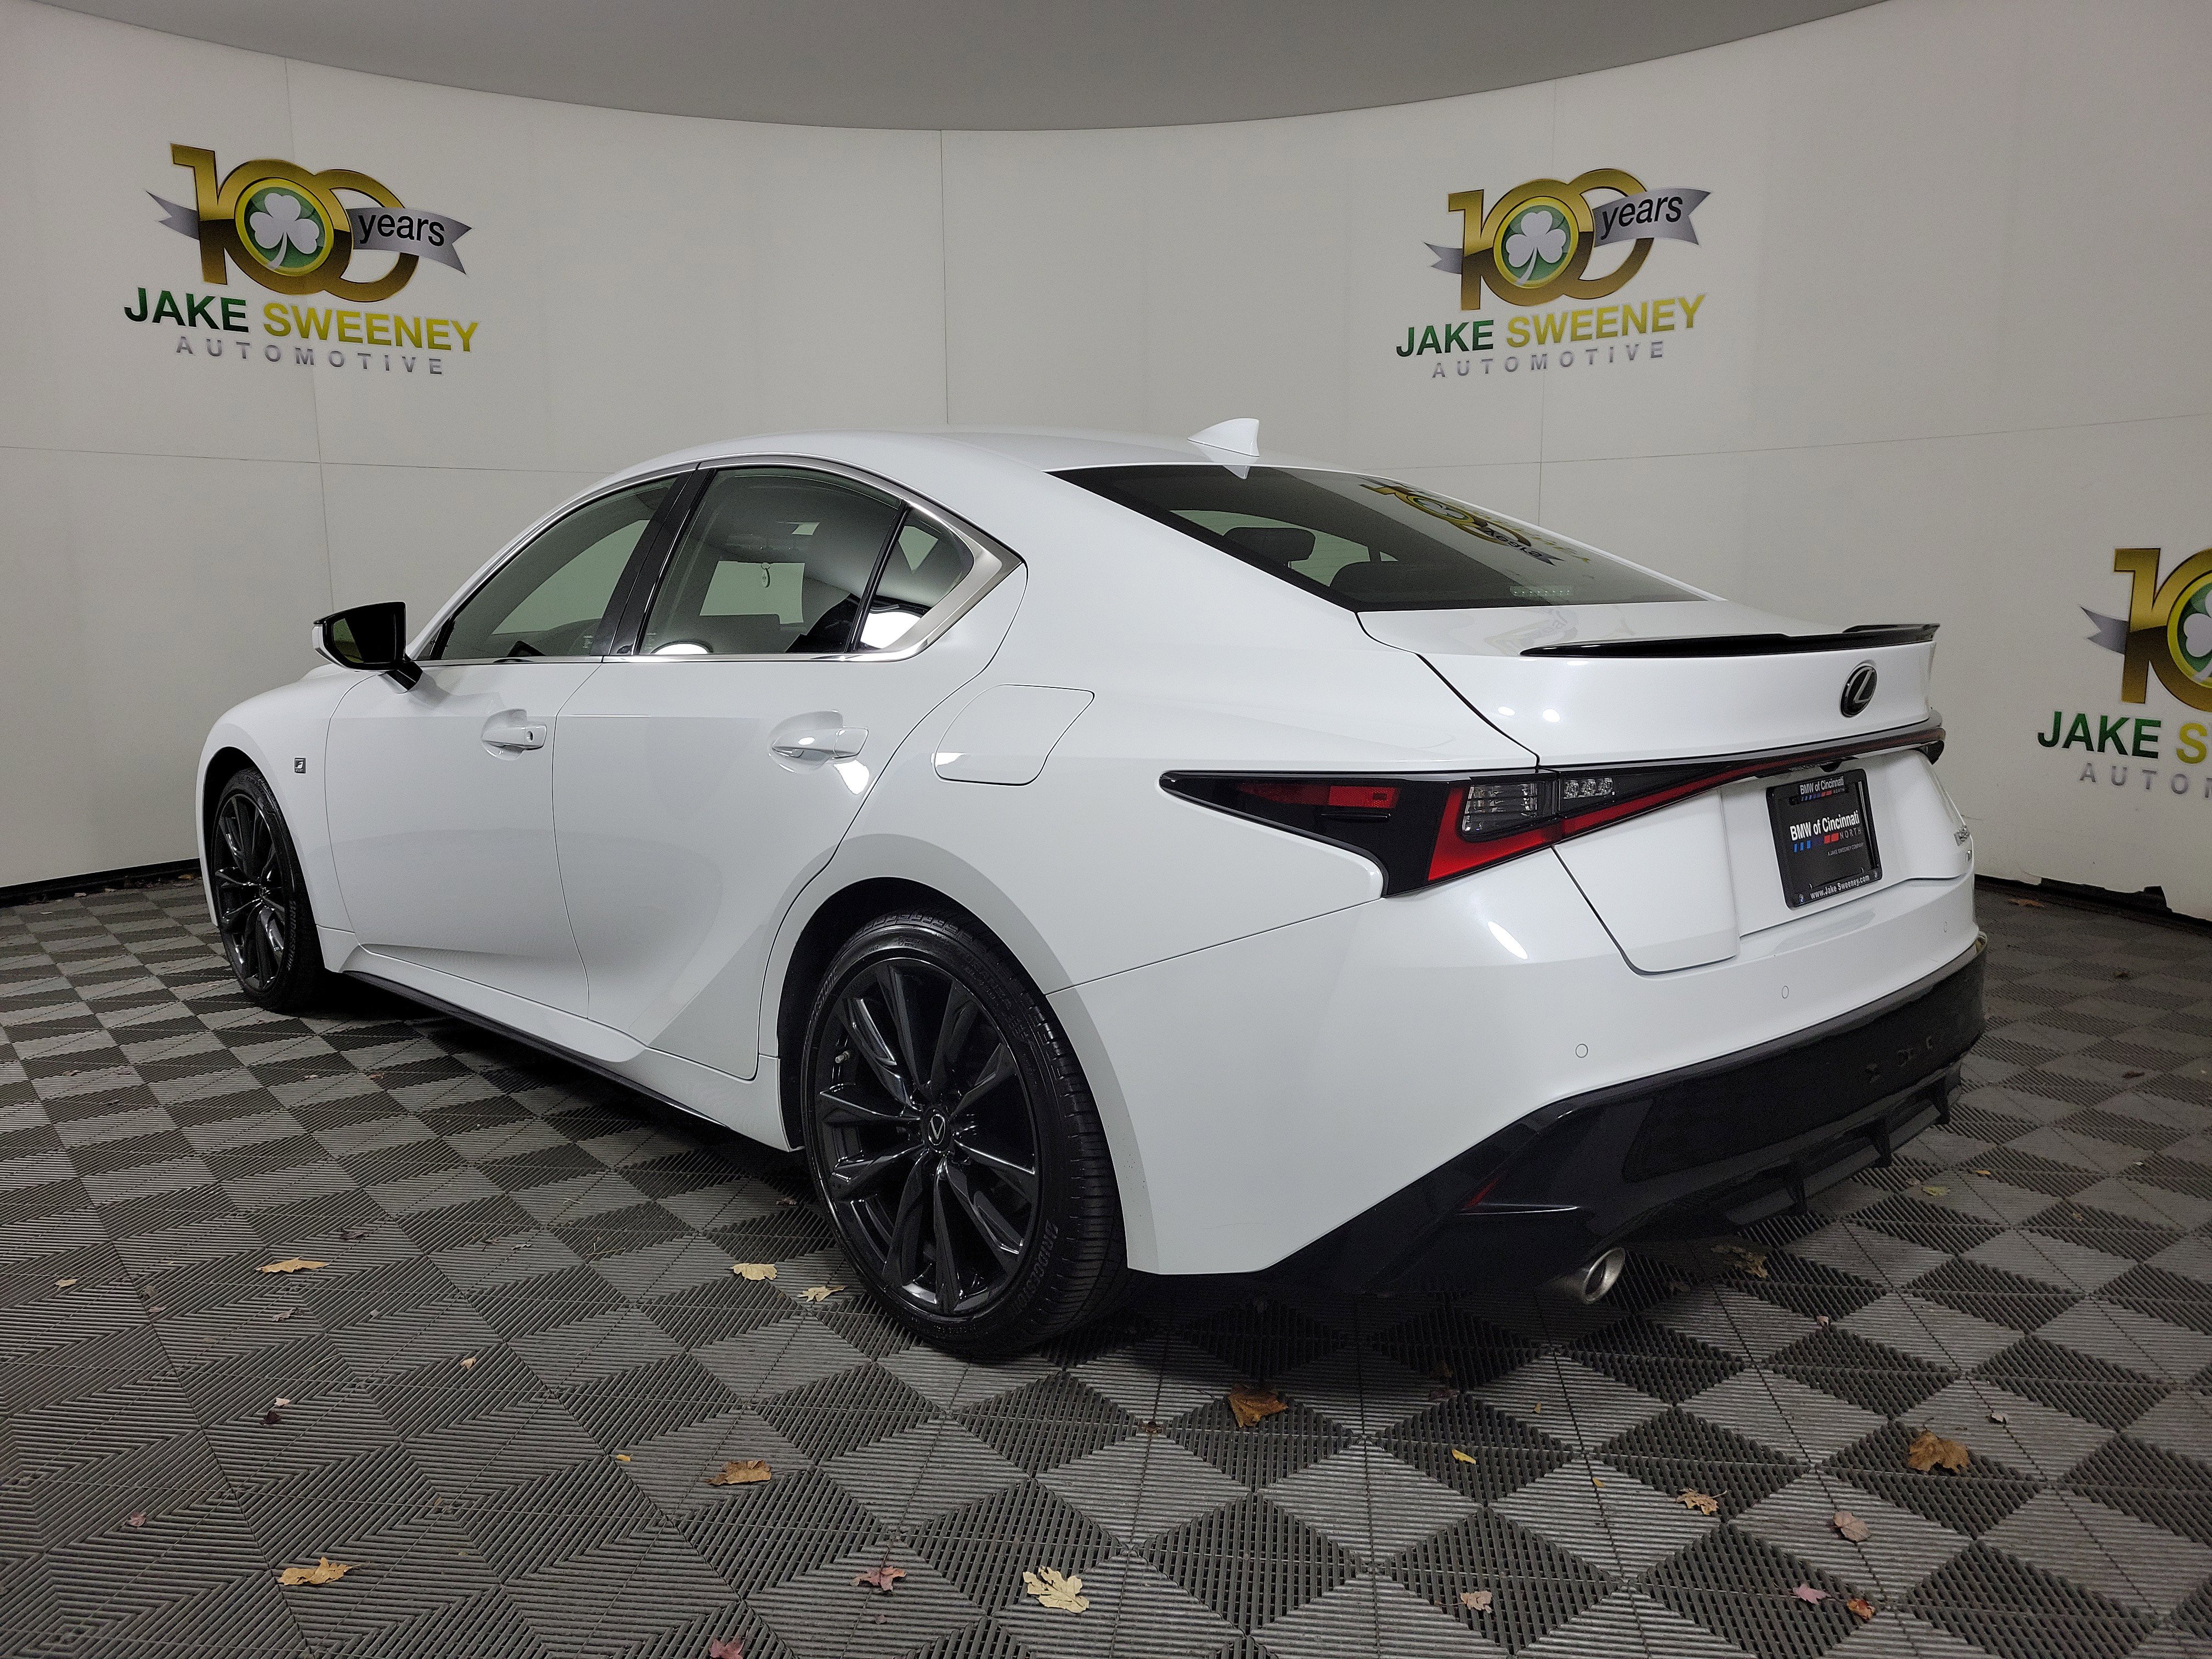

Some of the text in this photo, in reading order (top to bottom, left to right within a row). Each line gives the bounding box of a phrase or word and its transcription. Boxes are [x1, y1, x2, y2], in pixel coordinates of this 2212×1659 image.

[170, 143, 445, 303] 100 years
[1448, 168, 1684, 310] 100 years
[124, 287, 478, 352] JAKE SWEENEY
[1396, 295, 1706, 357] JAKE SWEENEY
[176, 336, 443, 375] AUTOMOTIVE
[1432, 341, 1663, 378] AUTOMOTIVE
[2038, 711, 2162, 759] JAKE
[1800, 776, 1844, 795] BMW of Cincinnati
[2080, 763, 2212, 798] AUTO
[1790, 809, 1859, 840] BMW of Cincinnati
[1839, 827, 1861, 839] NORTH
